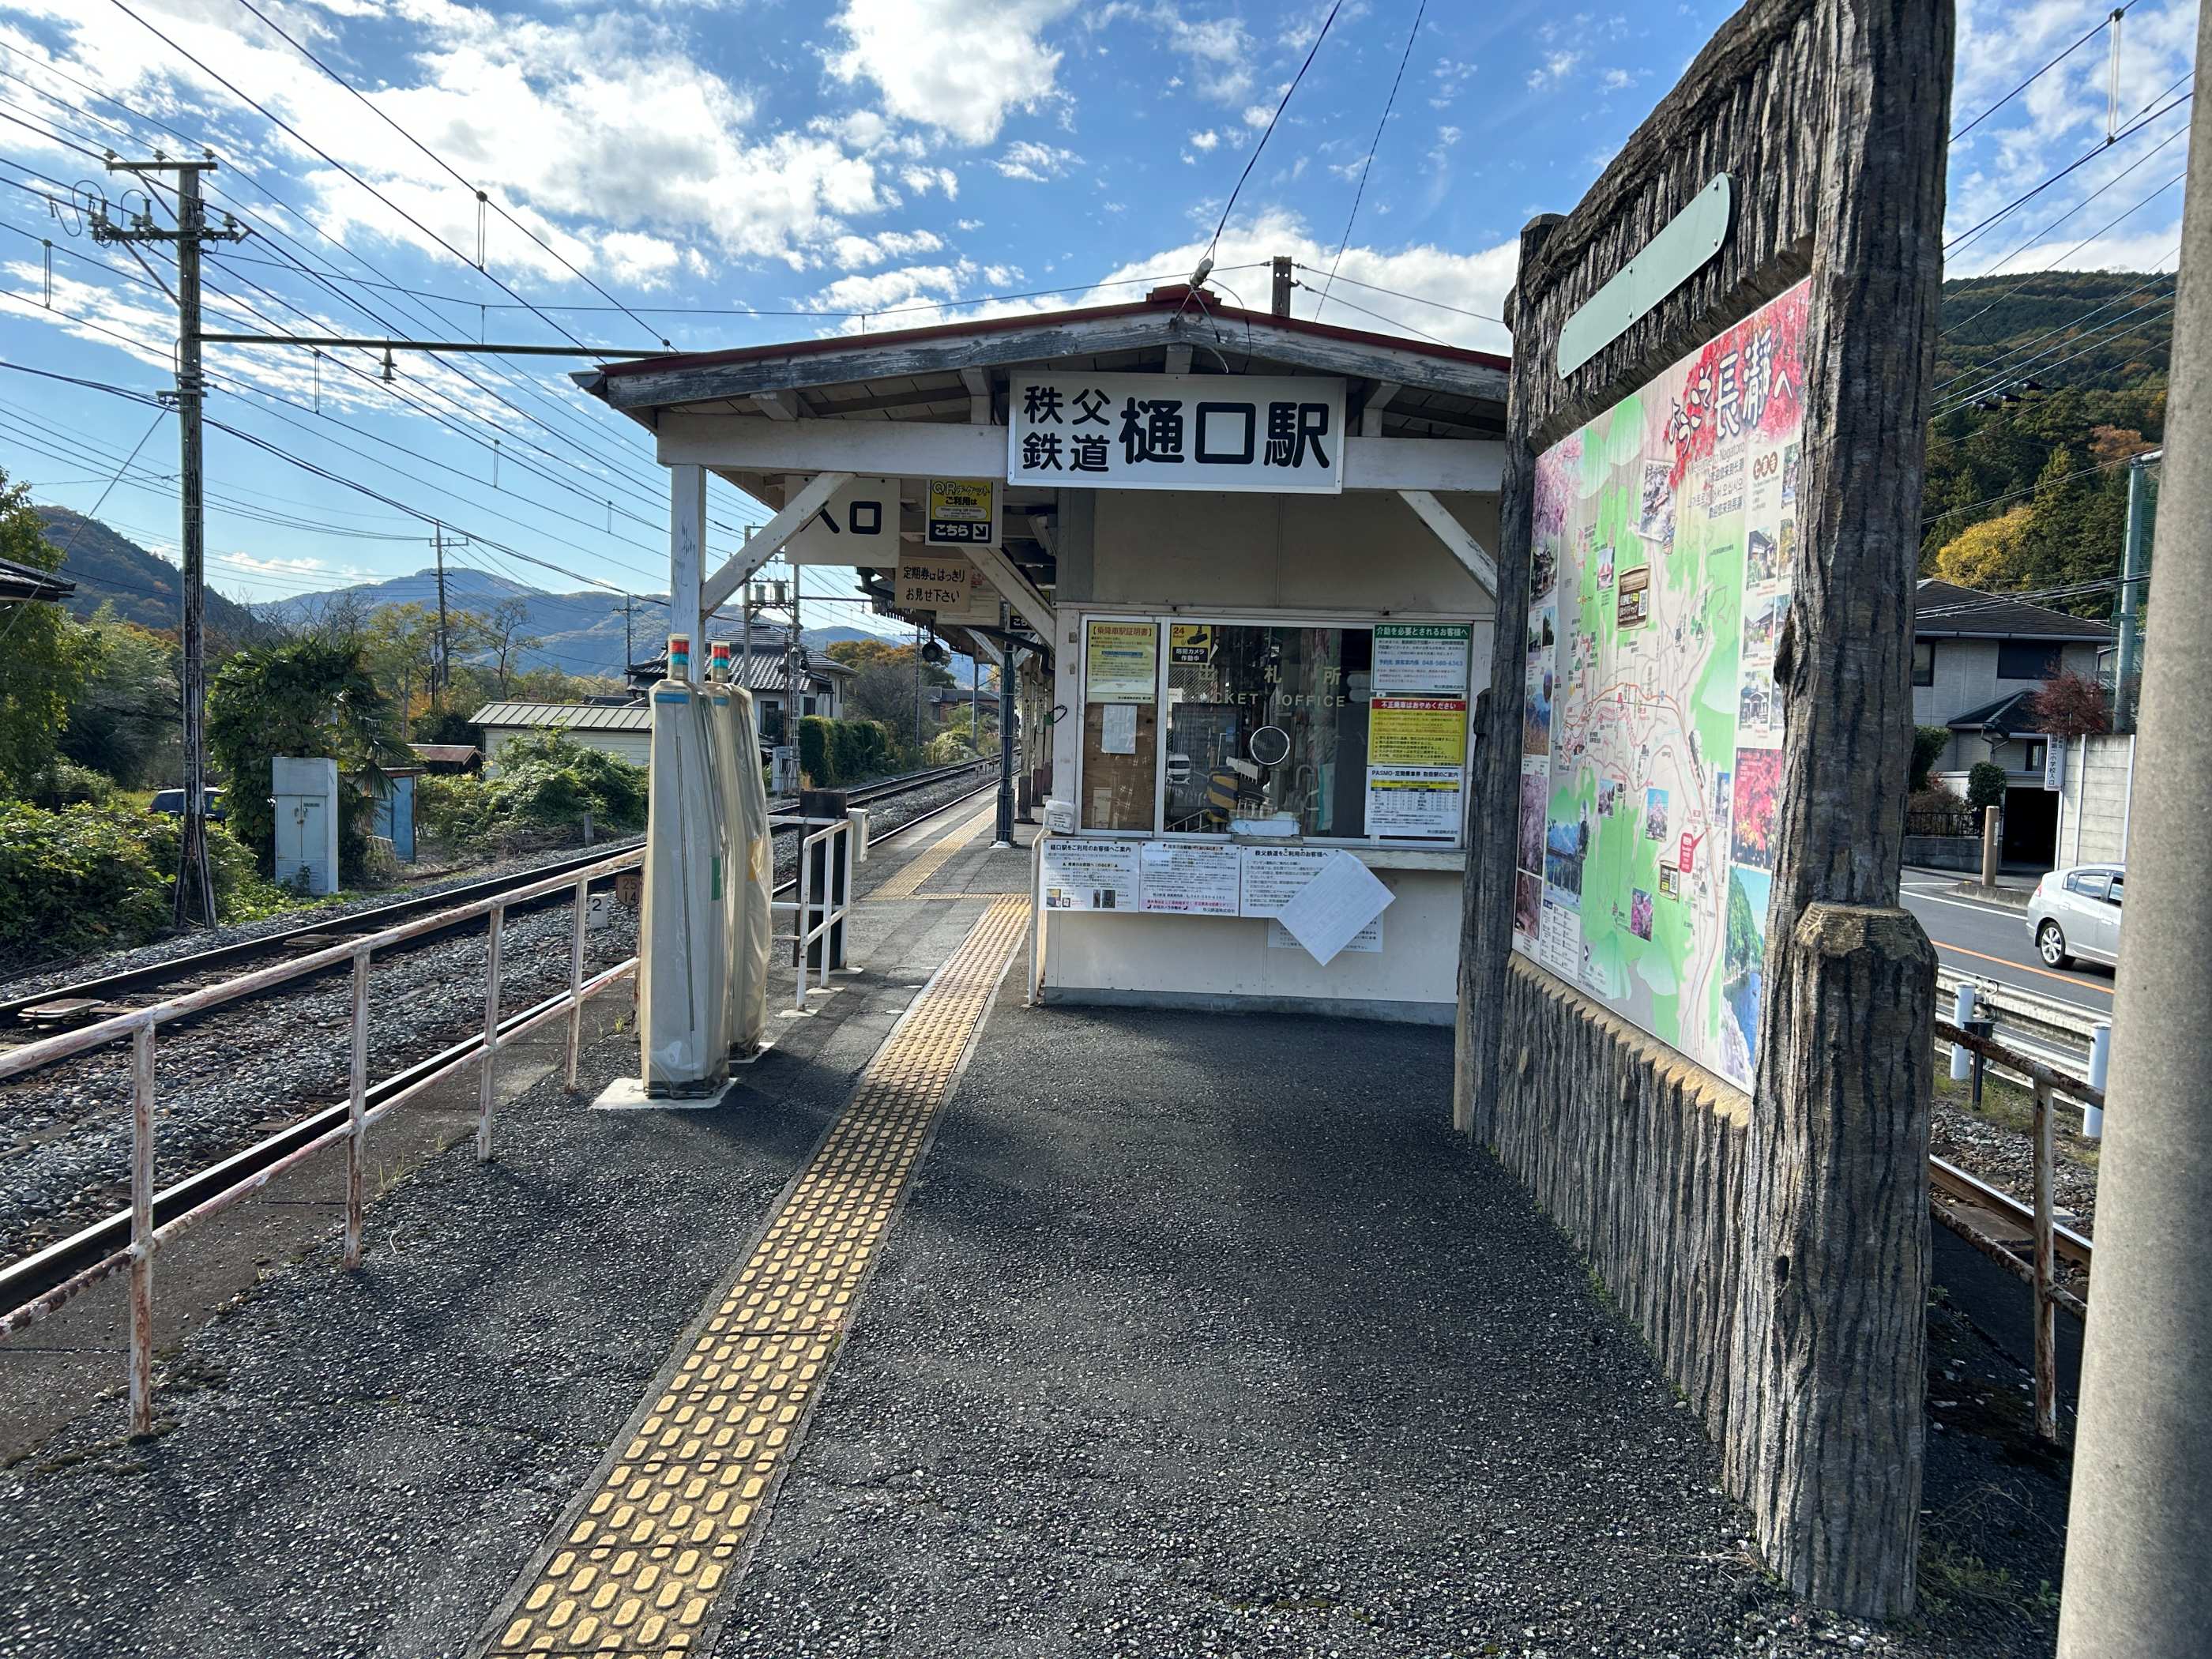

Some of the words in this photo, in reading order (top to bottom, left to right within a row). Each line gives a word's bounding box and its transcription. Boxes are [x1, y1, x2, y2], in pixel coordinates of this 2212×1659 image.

[1024, 386, 1111, 426] 秩父
[1118, 397, 1330, 469] 樋口駅
[1022, 432, 1110, 472] 鉄道
[946, 496, 978, 506] ご利用は
[935, 525, 969, 536] こちら
[903, 566, 966, 583] 定期券ははっきり
[906, 587, 961, 604] お見せ下さい
[1013, 618, 1031, 626] こち
[1376, 626, 1468, 636] 介助を必要とされるお客様へ
[1281, 694, 1345, 707] OFFICE
[623, 878, 637, 890] 25
[624, 891, 638, 903] 14
[592, 898, 601, 912] 2
